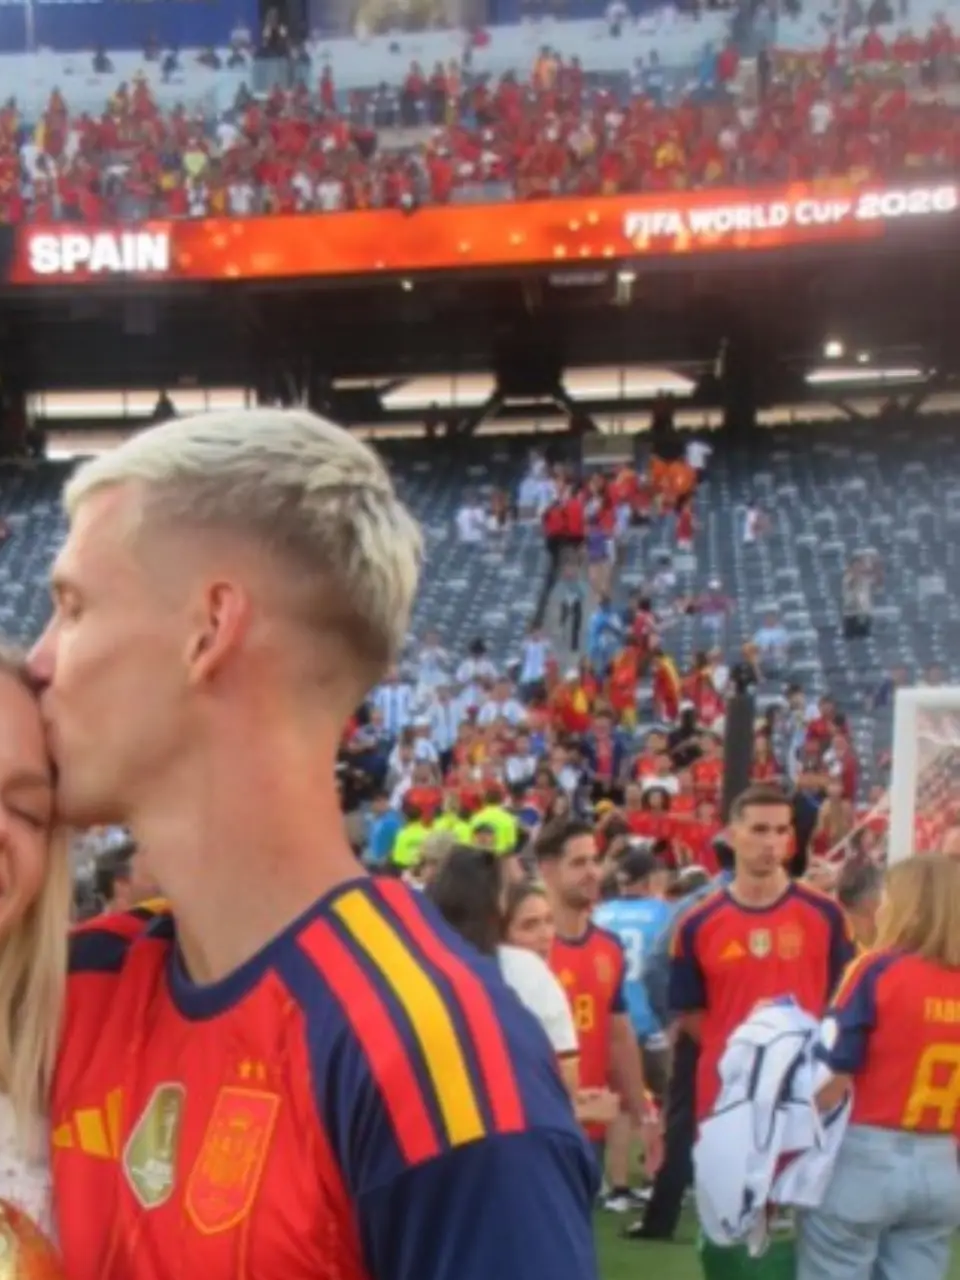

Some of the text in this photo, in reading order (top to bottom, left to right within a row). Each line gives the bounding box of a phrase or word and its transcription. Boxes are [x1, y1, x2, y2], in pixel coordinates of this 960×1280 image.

[624, 184, 958, 240] FIFA WORLD CUP 2026
[29, 232, 170, 274] SPAIN
